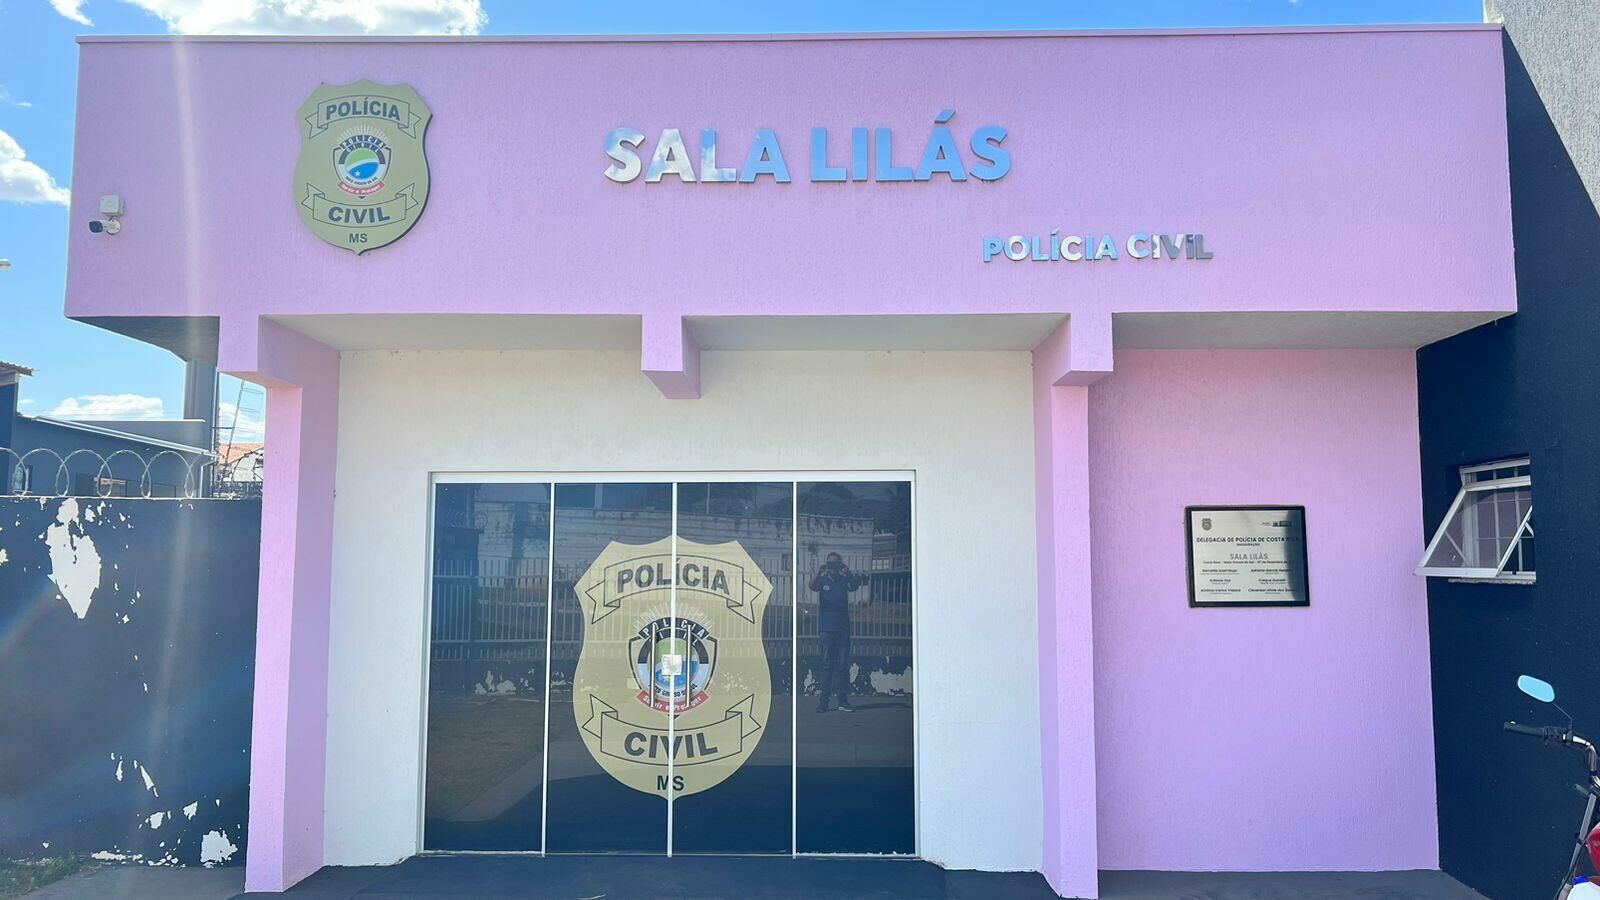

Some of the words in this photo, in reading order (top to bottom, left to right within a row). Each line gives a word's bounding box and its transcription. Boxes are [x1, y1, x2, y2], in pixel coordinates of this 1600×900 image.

[326, 97, 401, 121] POLÍCIA
[603, 126, 792, 185] SALA
[810, 108, 1012, 184] LILÁS
[328, 206, 391, 224] CIVIL
[349, 233, 368, 243] MS
[984, 227, 1119, 262] POLÍCIA
[1126, 232, 1214, 261] CIVIL
[1235, 535, 1257, 543] POLÍCIA
[617, 557, 730, 595] POLÍCIA
[624, 732, 718, 759] CIVIL
[657, 774, 685, 792] MS
